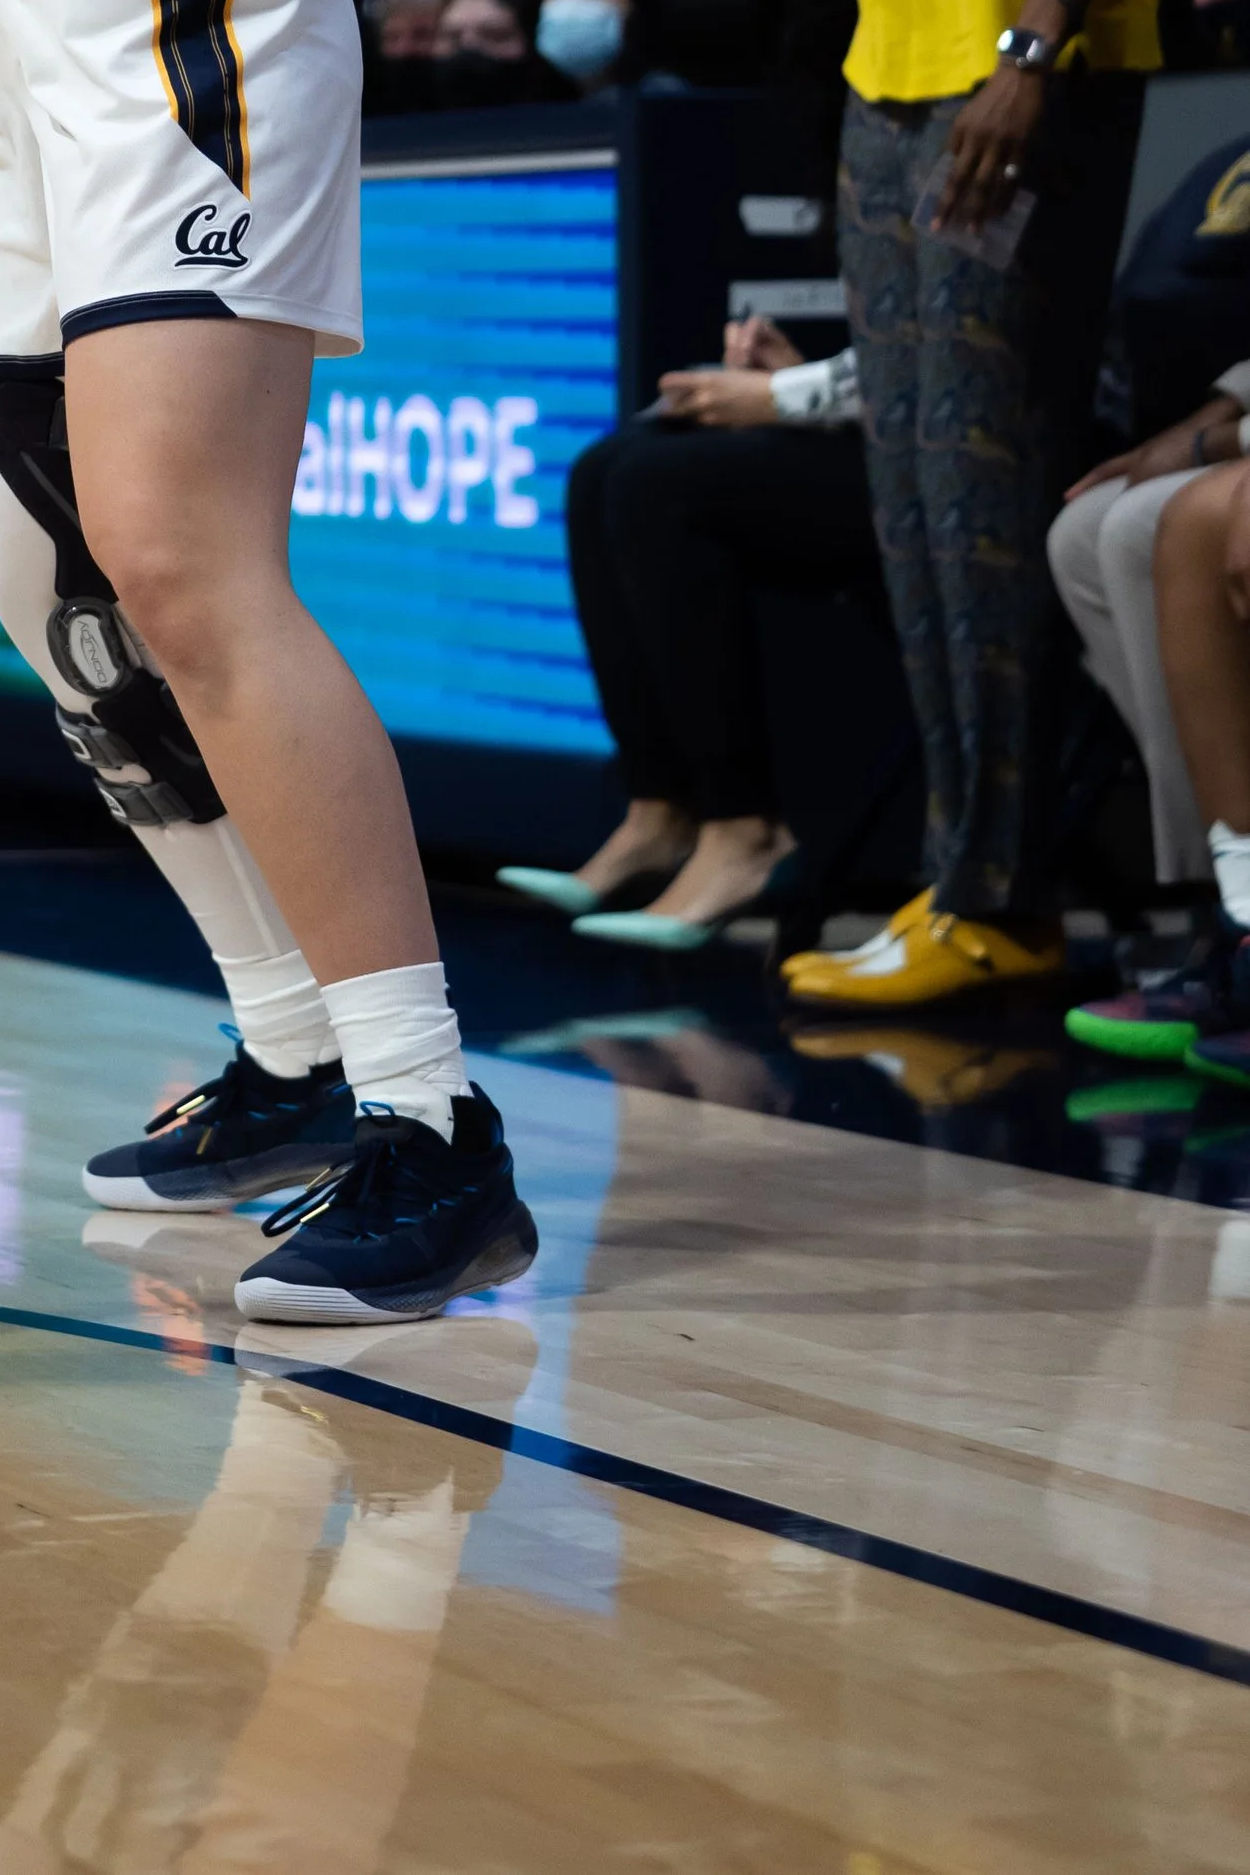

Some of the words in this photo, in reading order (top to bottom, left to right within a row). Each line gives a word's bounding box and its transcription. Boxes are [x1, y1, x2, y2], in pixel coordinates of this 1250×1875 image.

[174, 204, 251, 268] Cal
[291, 390, 540, 529] alHOPE
[78, 621, 107, 683] DONJOY
